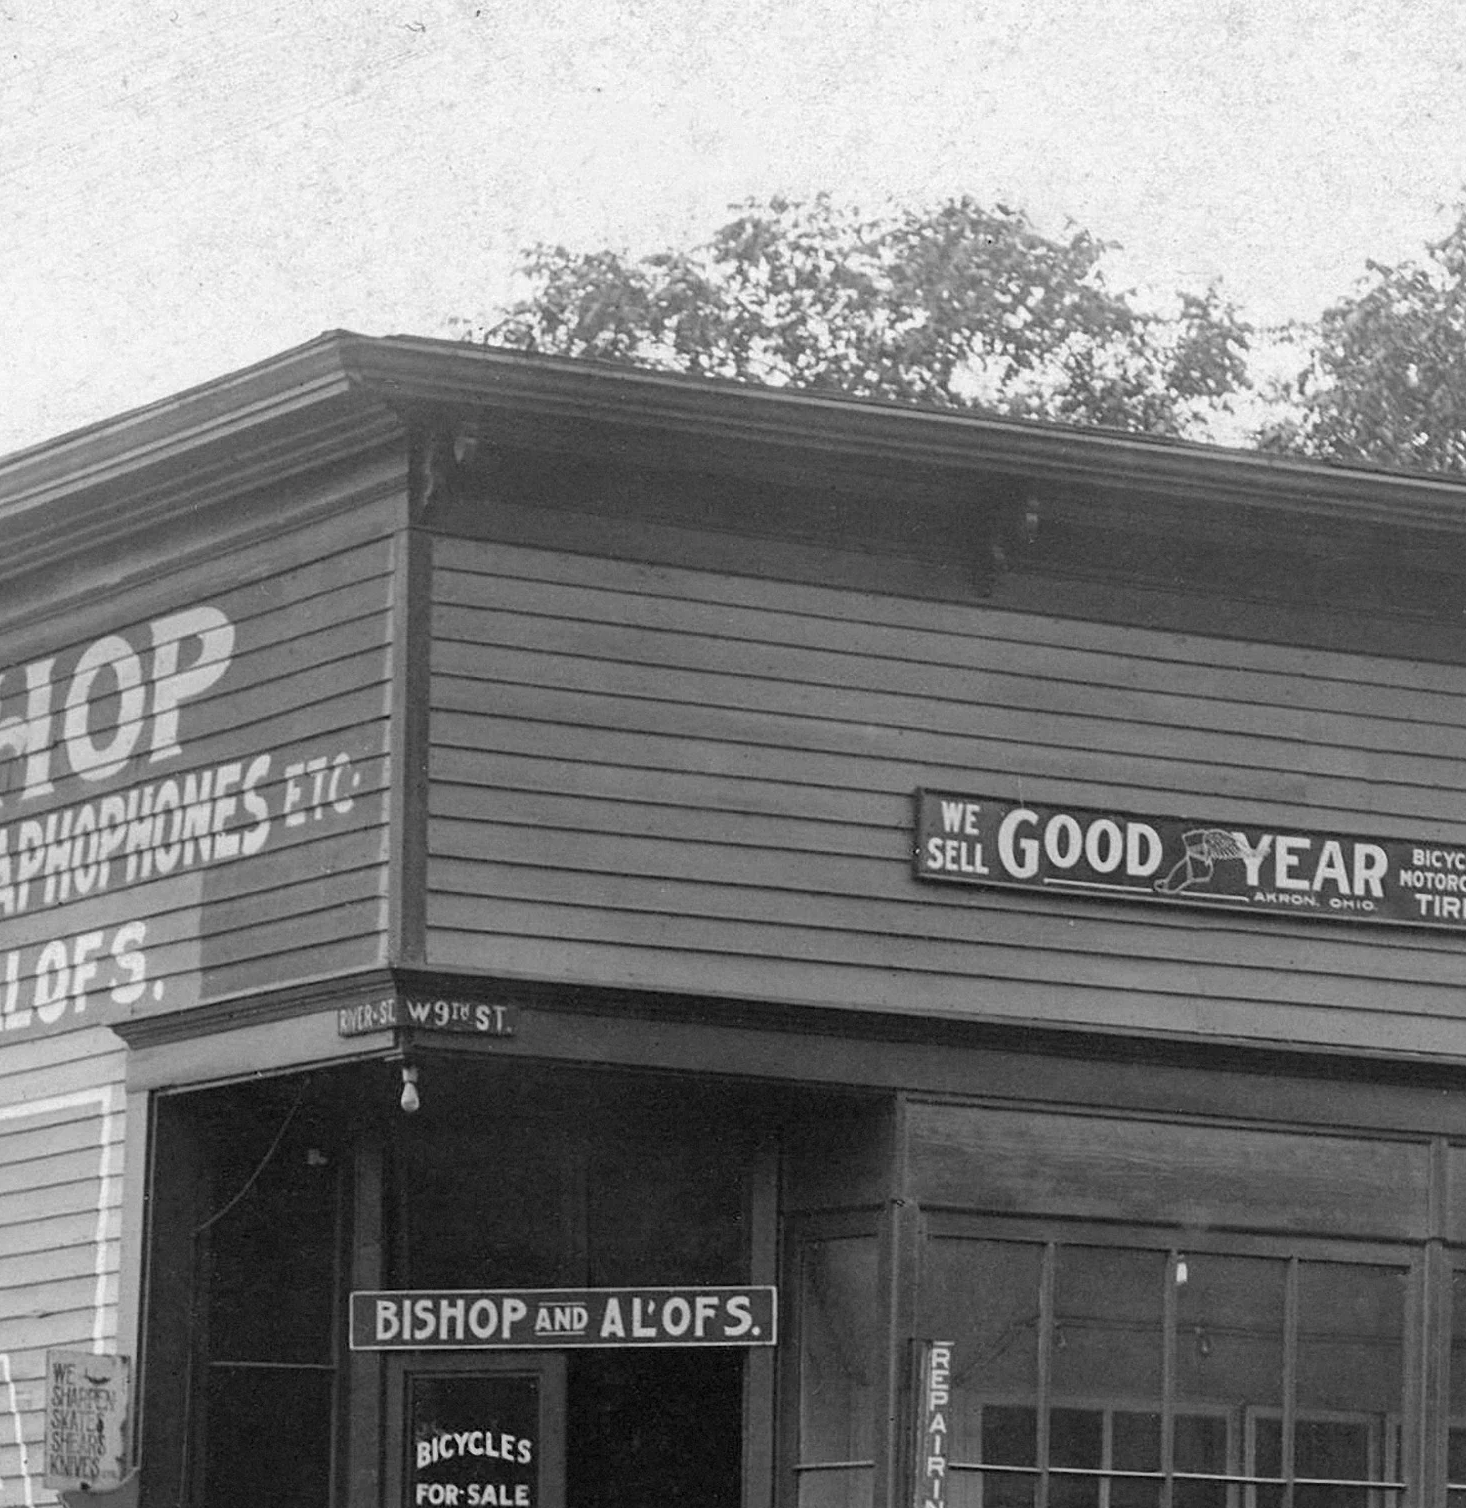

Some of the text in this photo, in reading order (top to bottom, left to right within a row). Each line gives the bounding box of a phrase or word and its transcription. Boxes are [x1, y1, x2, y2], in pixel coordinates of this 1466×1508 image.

[940, 800, 981, 836] WE
[927, 836, 990, 875] SELL
[997, 807, 1390, 899] GOOD YEAR
[375, 1297, 528, 1341] BISHOP
[534, 1305, 590, 1333] AND
[52, 1362, 76, 1385] WE
[416, 1430, 532, 1470] BICYCLES
